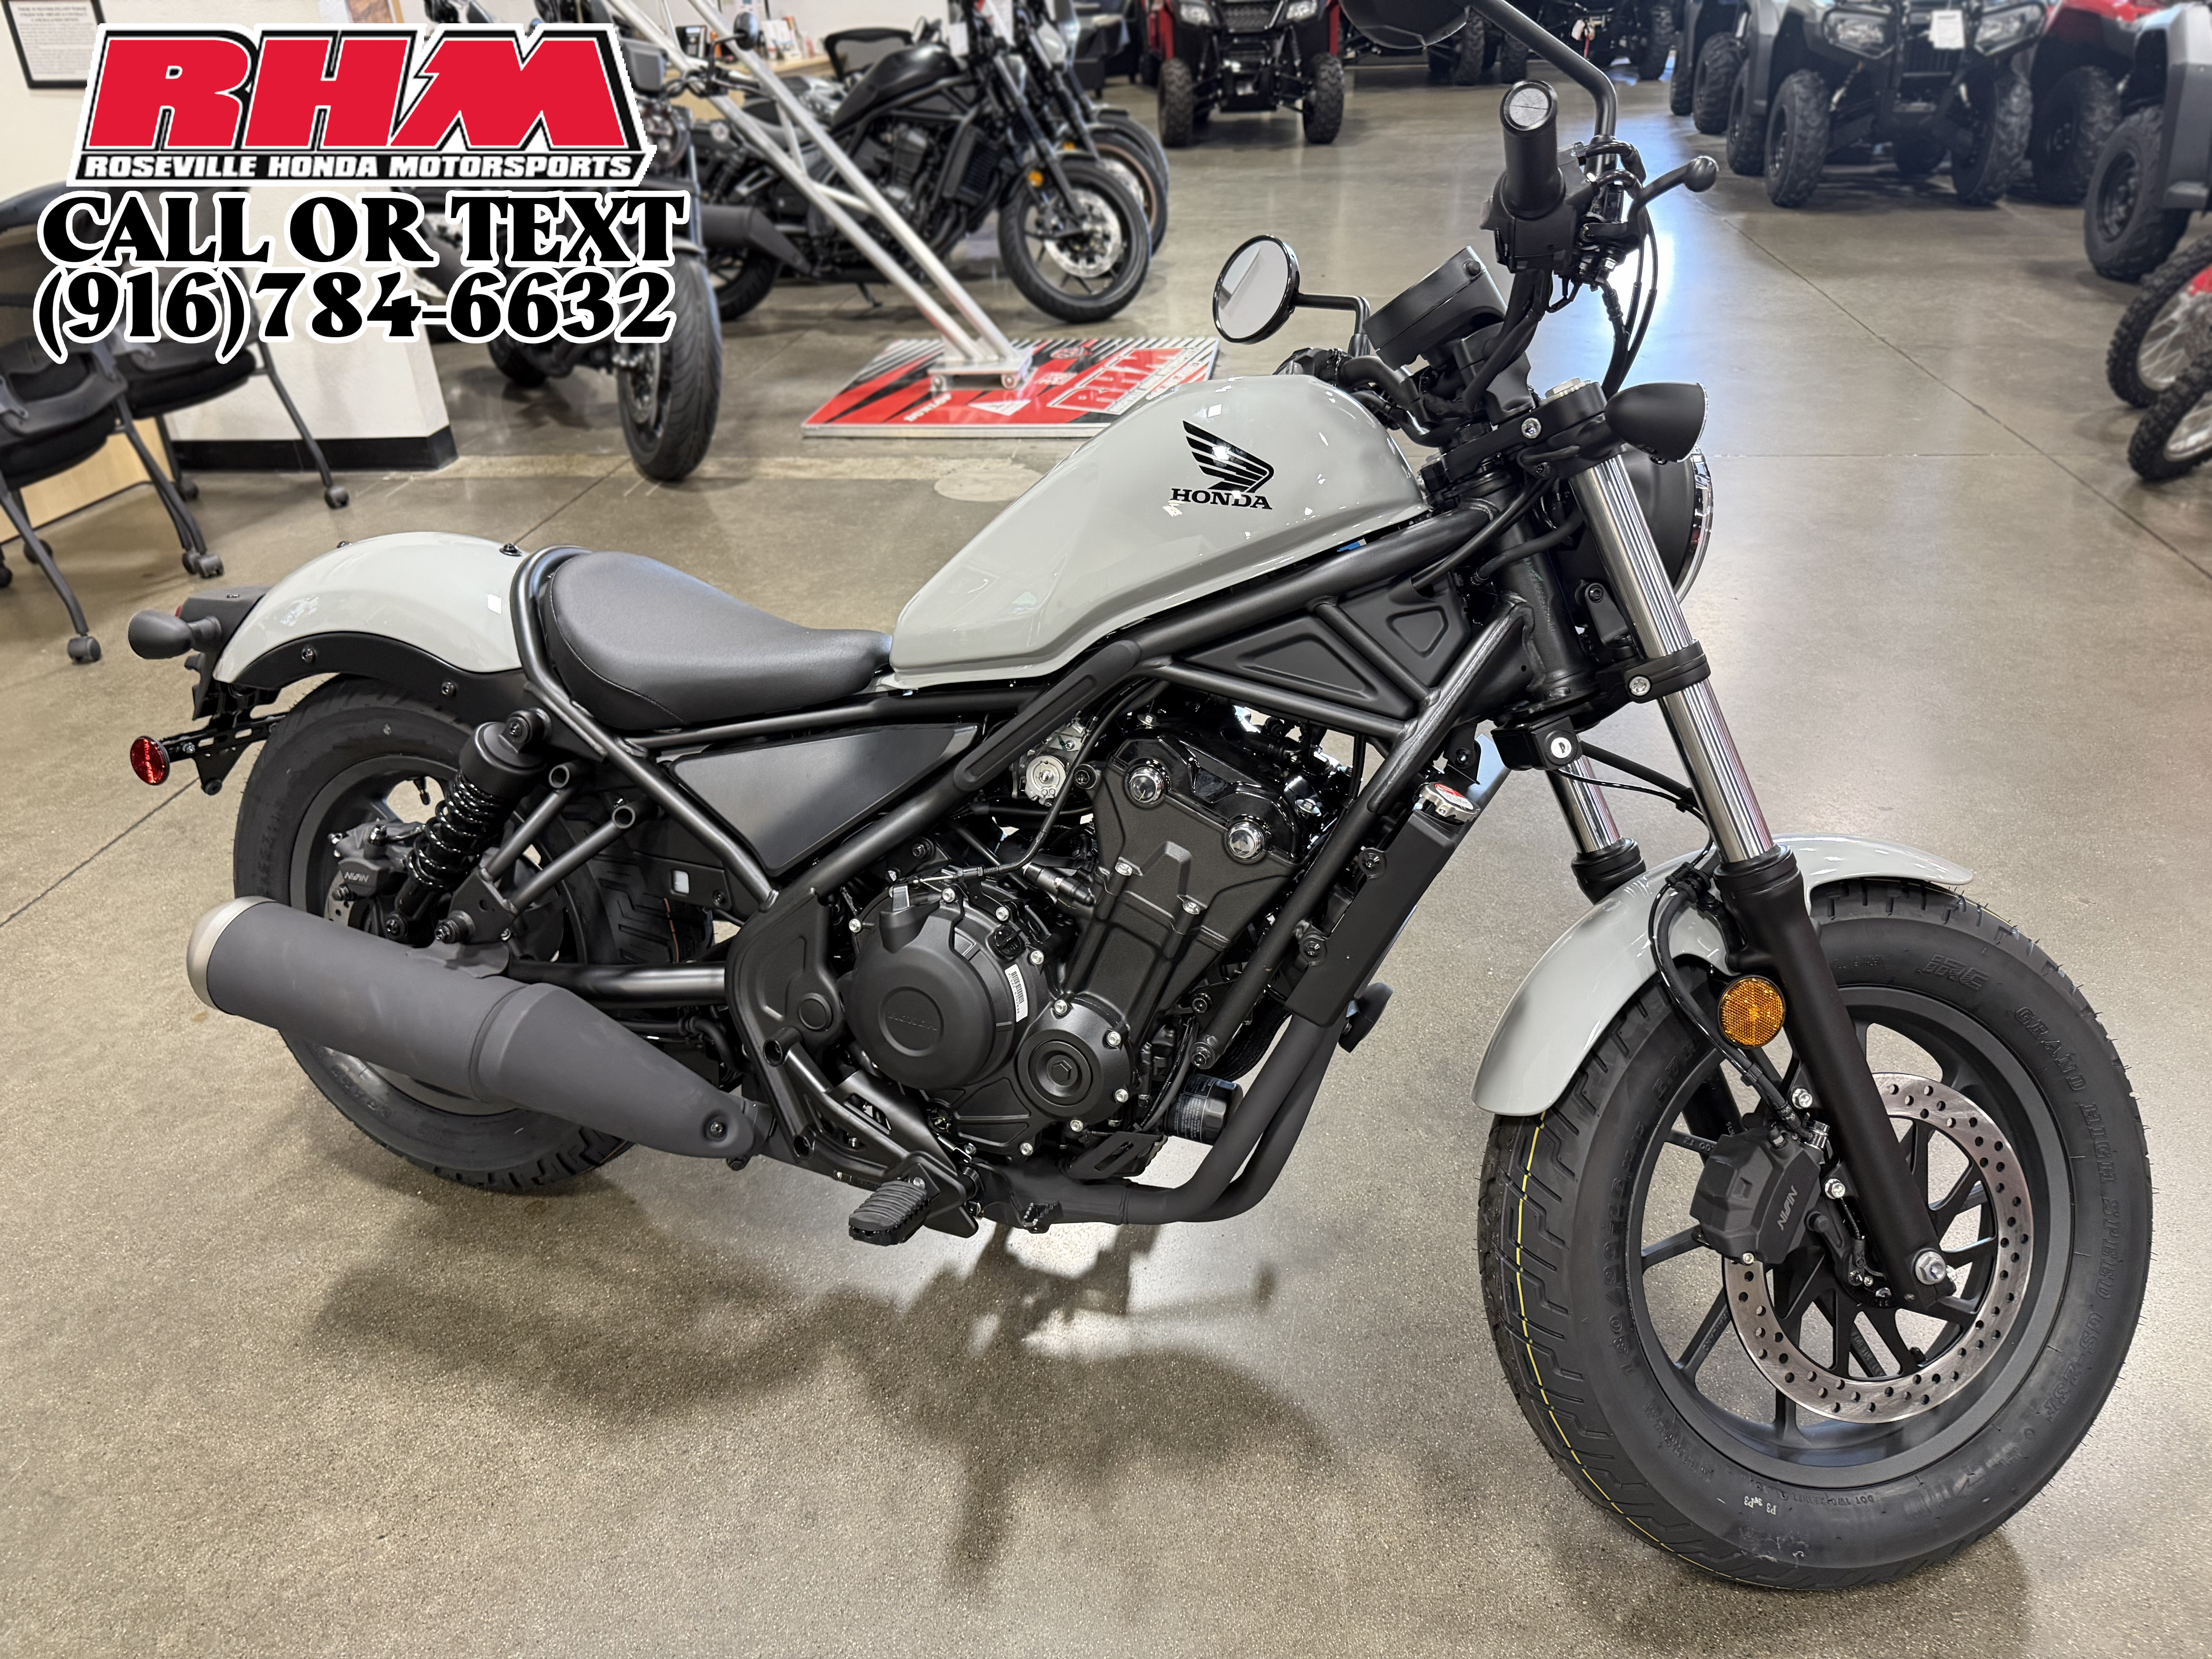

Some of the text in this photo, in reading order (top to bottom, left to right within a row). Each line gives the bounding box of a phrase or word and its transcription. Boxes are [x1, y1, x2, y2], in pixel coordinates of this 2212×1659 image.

[1170, 488, 1273, 510] HONDA
[2015, 1005, 2087, 1092] GRAND
[2083, 1102, 2117, 1185] HIGH
[2096, 1195, 2122, 1300] SPEED
